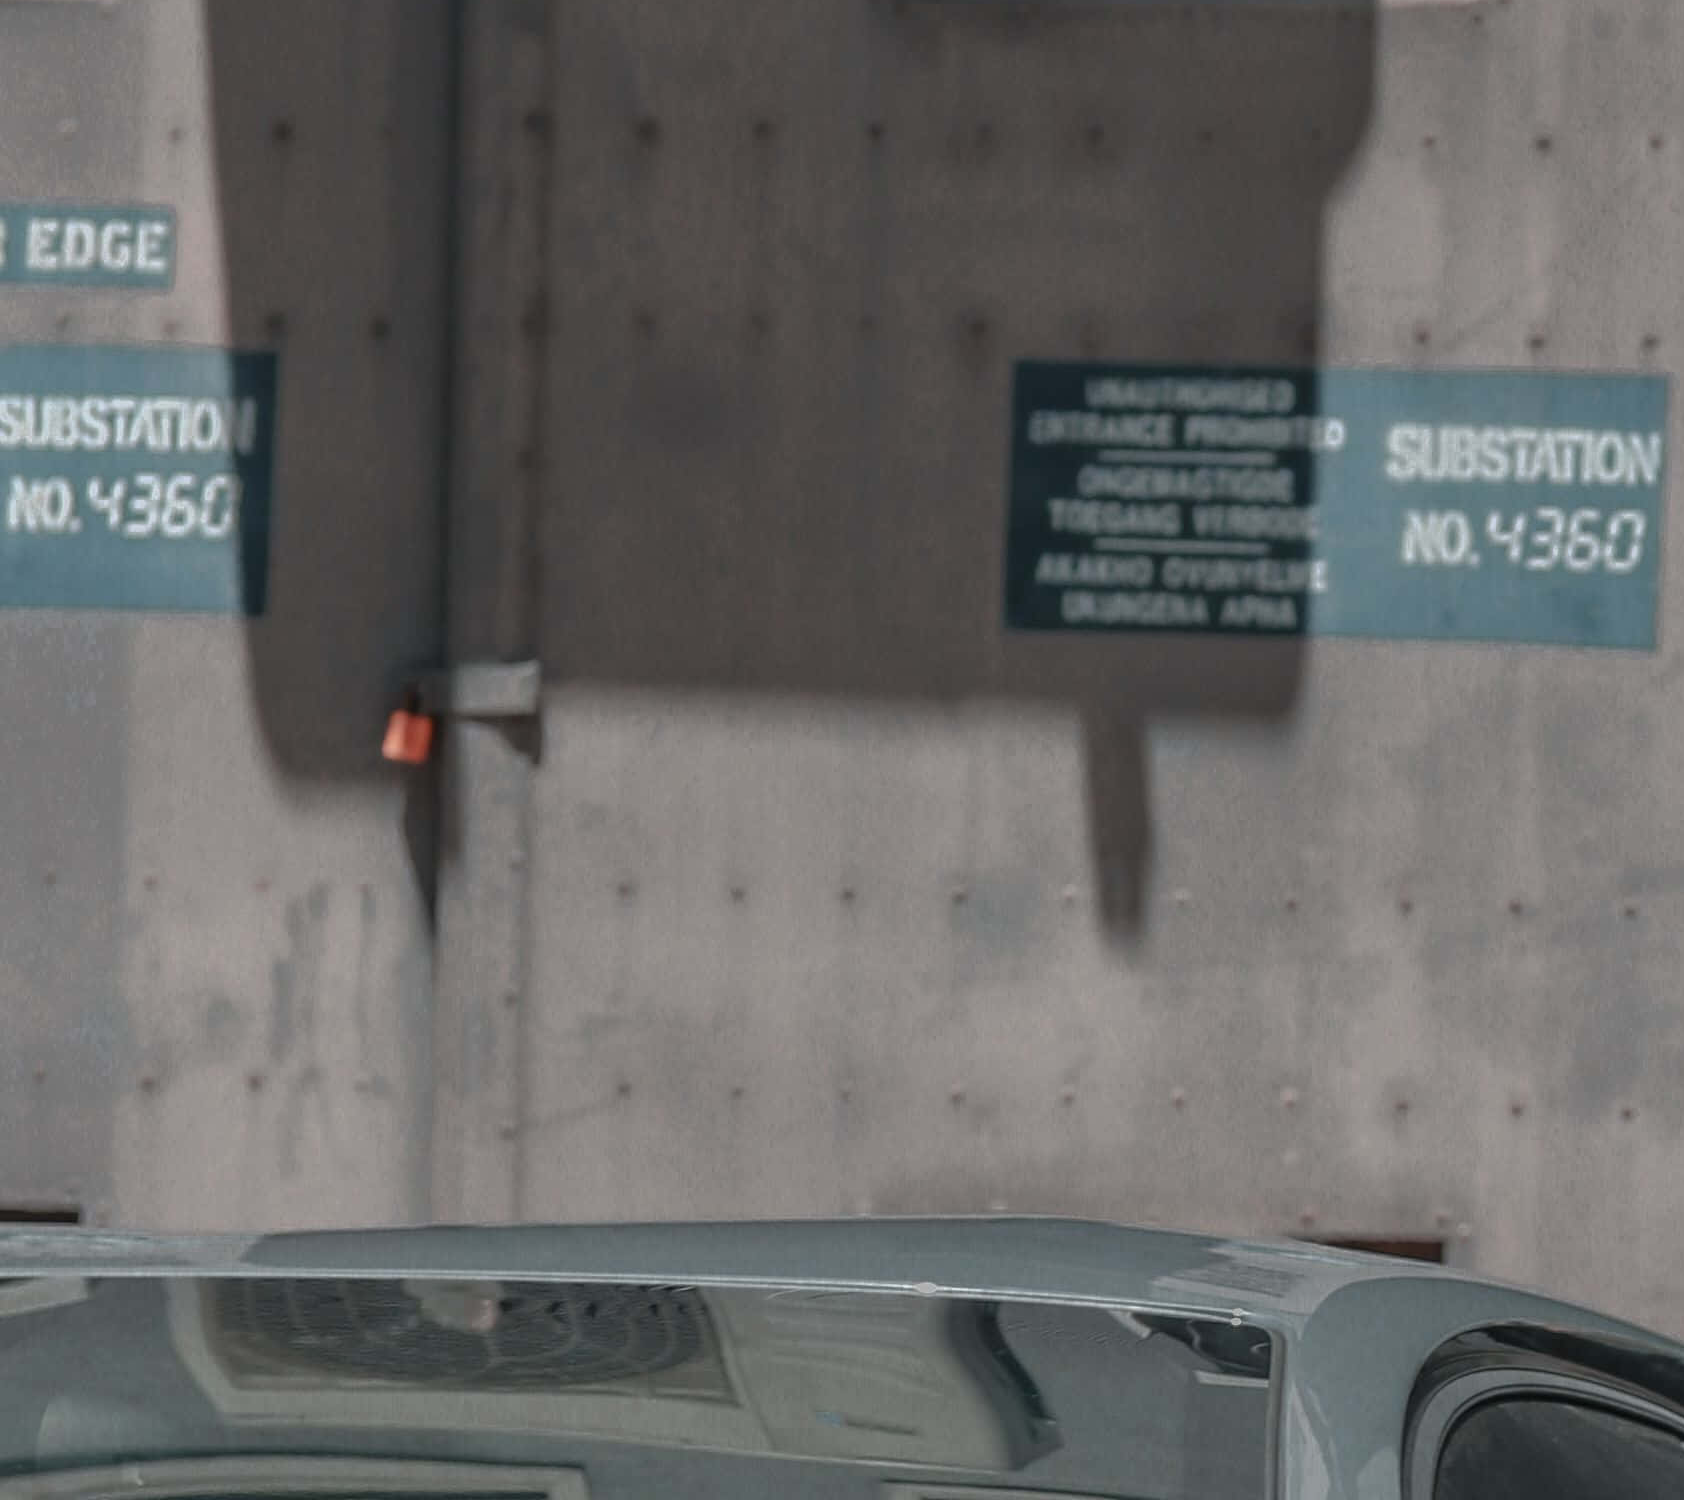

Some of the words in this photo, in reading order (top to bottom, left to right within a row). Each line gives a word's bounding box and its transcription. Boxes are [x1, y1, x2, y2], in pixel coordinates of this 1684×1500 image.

[26, 217, 169, 273] EDGE
[1029, 411, 1173, 447] ENTRANCE
[1386, 423, 1661, 485] SUBSTATION
[1048, 499, 1181, 535] TOEGANG
